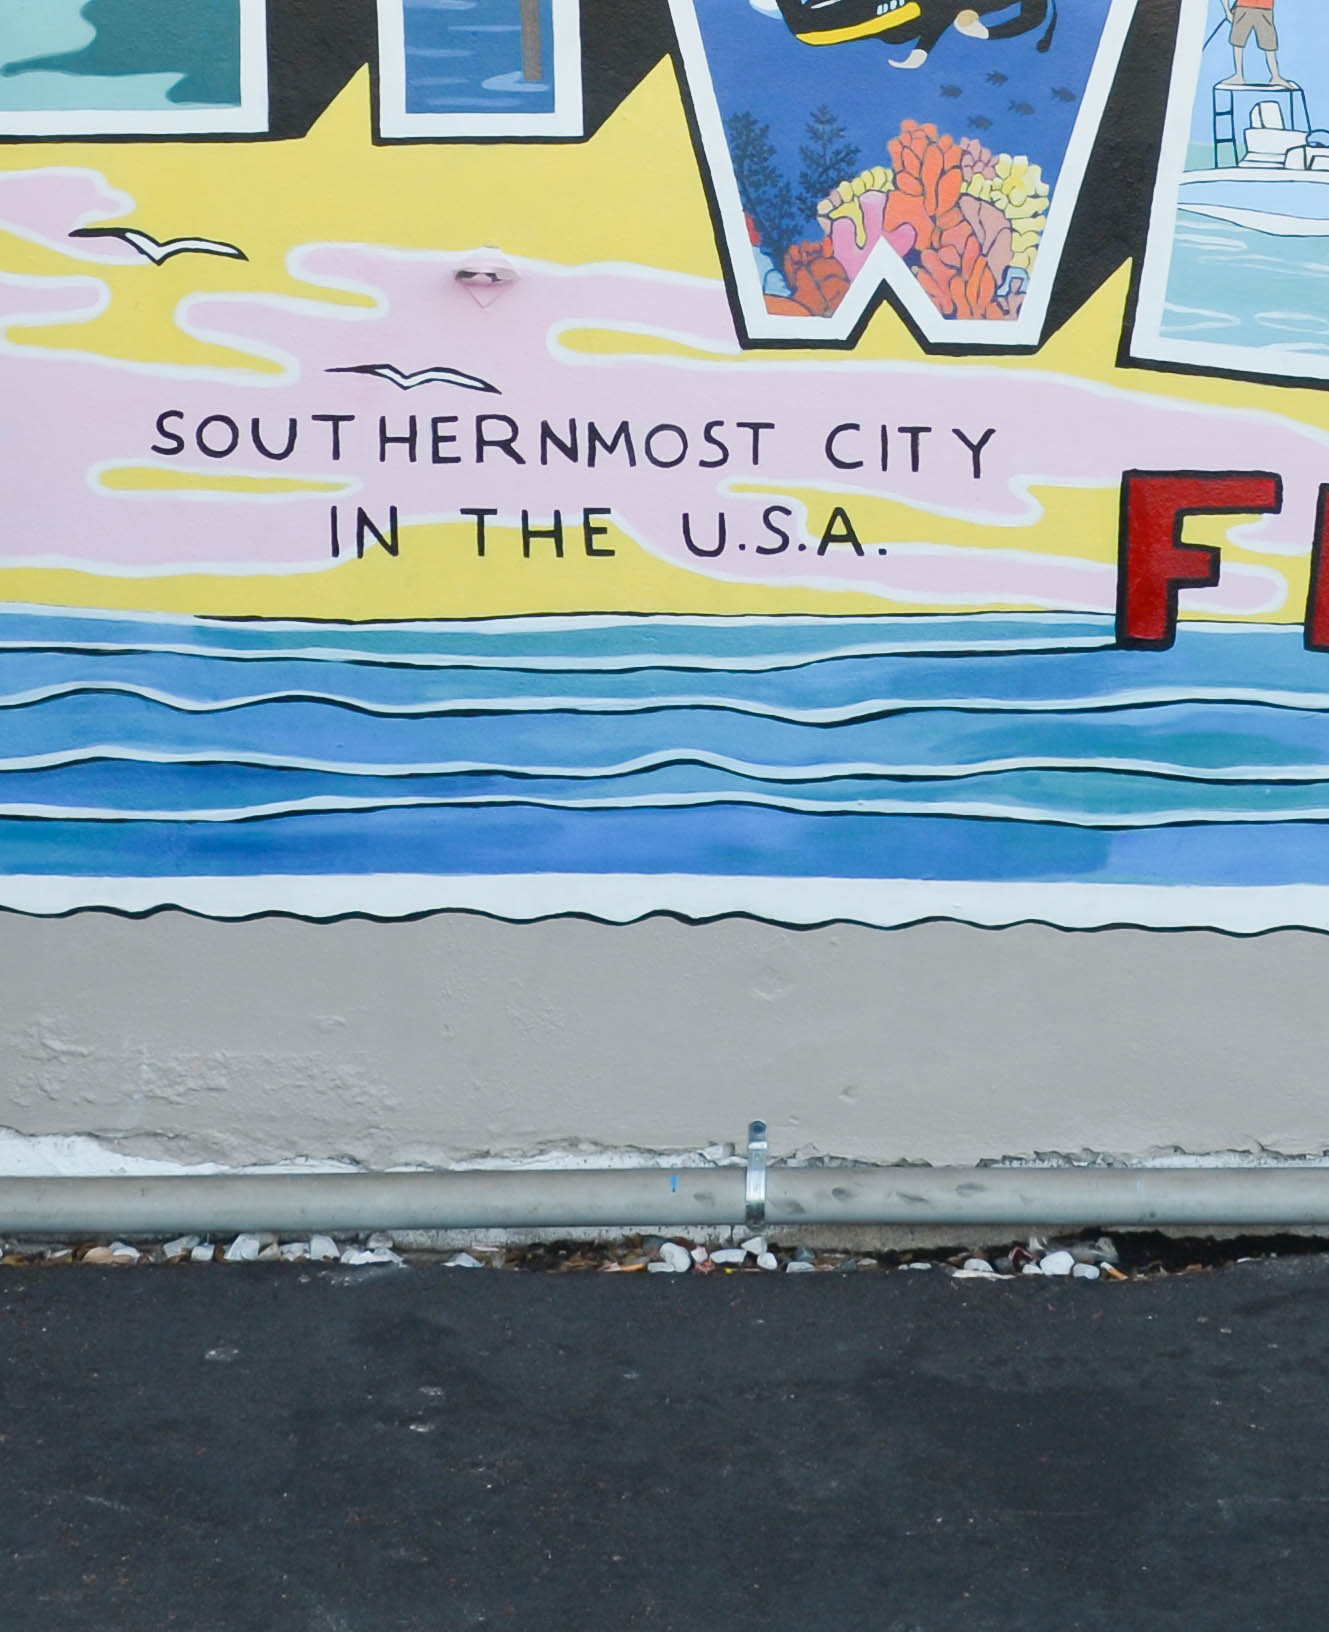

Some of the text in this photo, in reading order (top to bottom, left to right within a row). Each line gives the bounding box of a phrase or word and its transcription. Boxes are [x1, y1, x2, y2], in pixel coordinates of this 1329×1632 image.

[150, 409, 998, 479] SOUTHERNMOST CITY
[329, 504, 888, 559] IN THE U.S.A.
